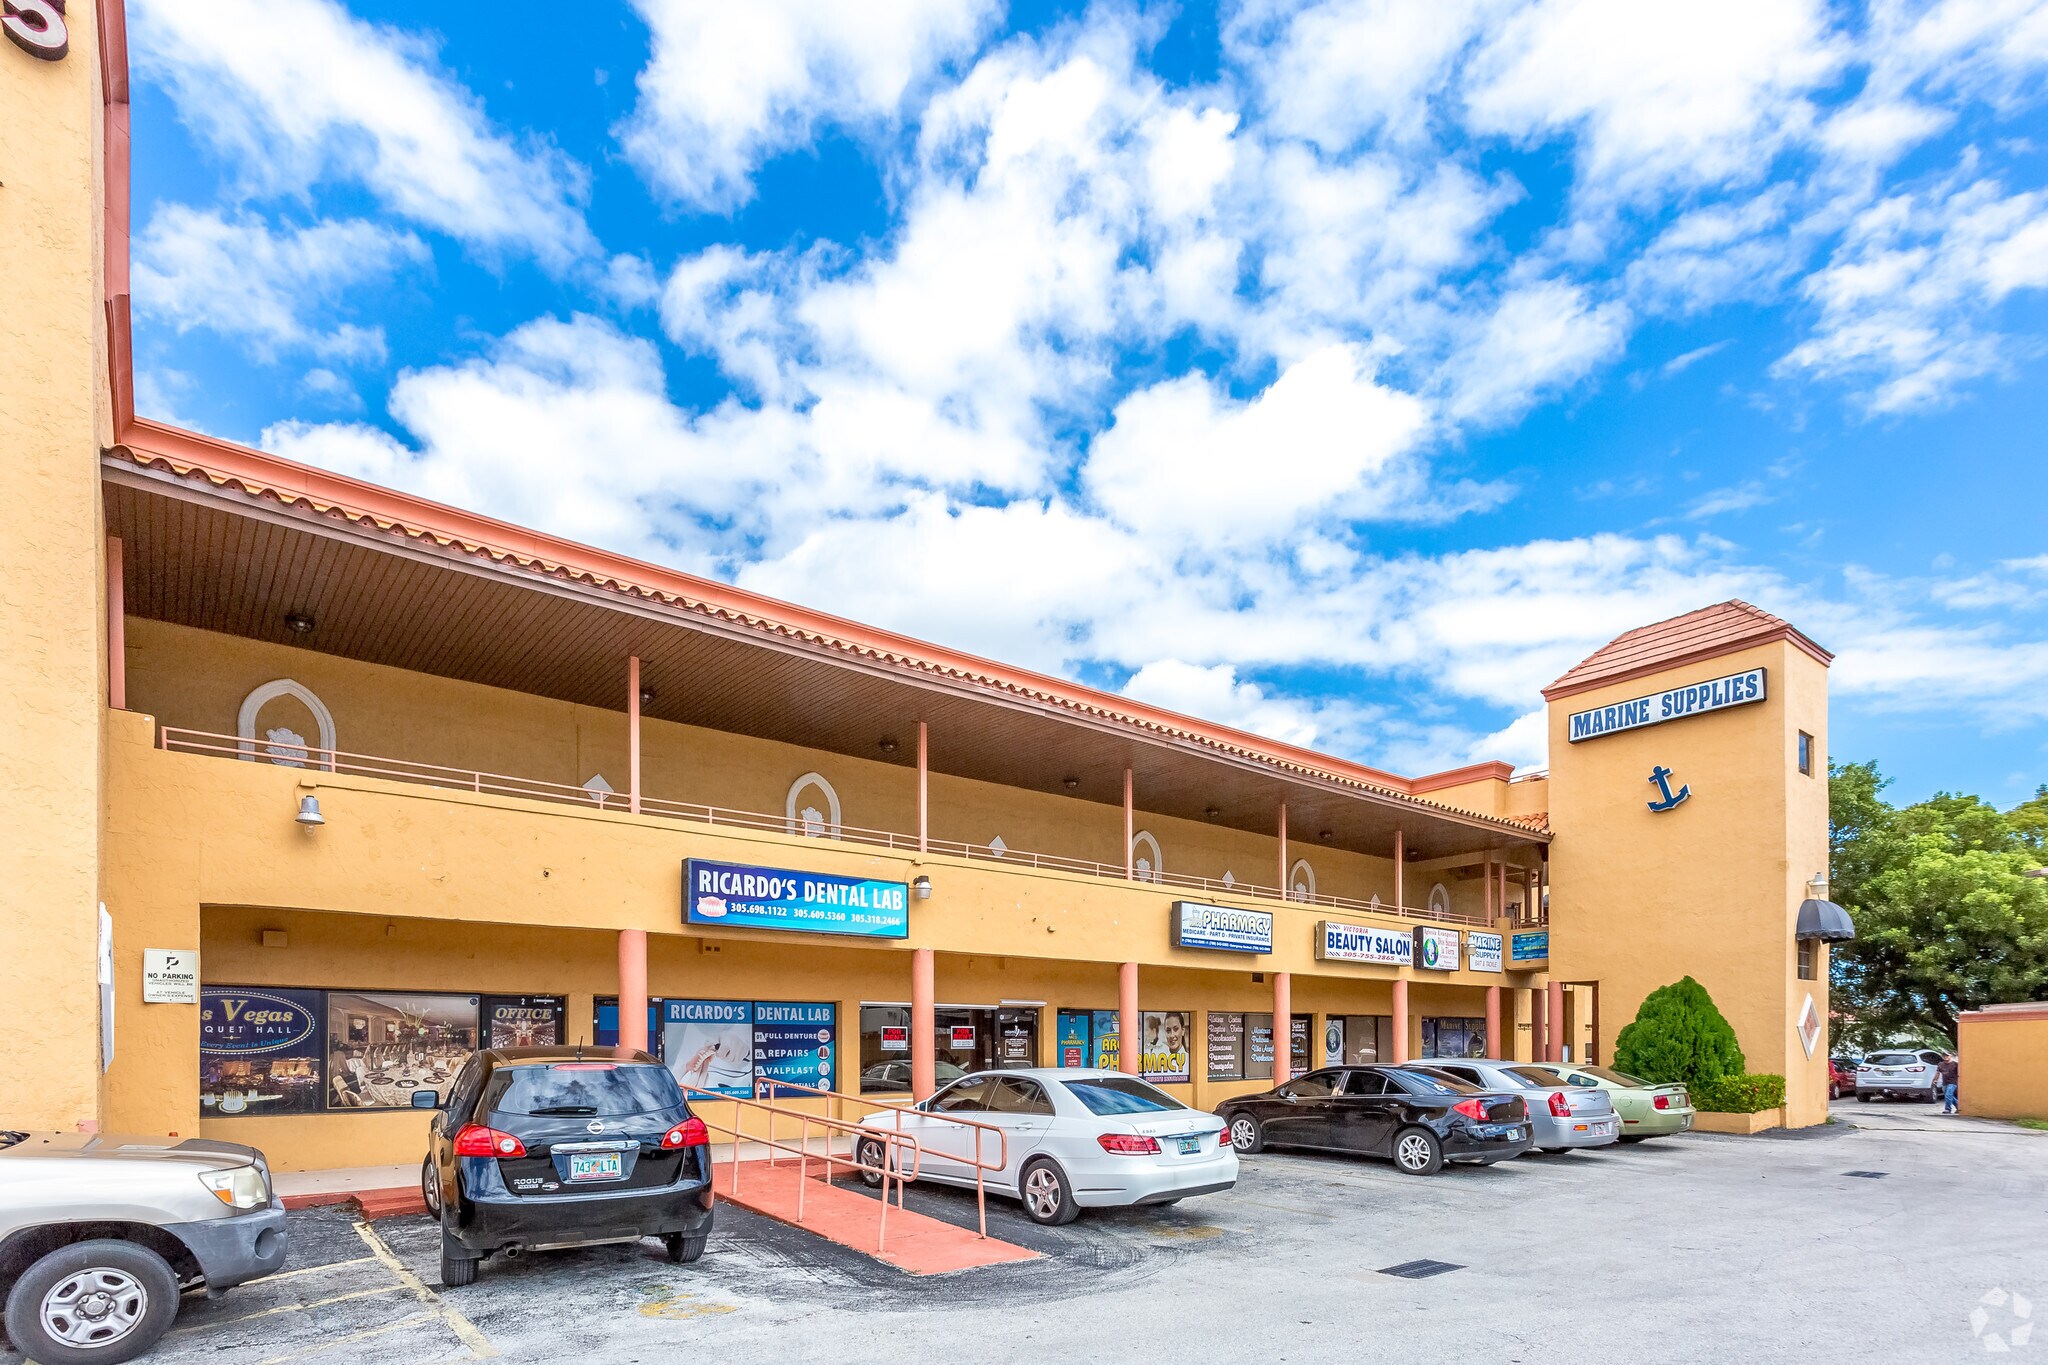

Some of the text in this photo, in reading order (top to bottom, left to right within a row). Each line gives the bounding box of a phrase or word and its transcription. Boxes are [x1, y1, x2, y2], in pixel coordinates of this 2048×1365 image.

[1574, 673, 1758, 738] MARINE SUPPLIES
[698, 869, 903, 911] RICARDO'S DENTAL LAB
[730, 902, 900, 926] 305.698.1122 305.609.5360 305.318.2466
[1203, 910, 1271, 936] PHARMACY
[1183, 928, 1206, 936] MEDICARE
[1343, 925, 1369, 934] VICTORIA
[1328, 932, 1410, 956] BEAUTY SALON
[1471, 935, 1501, 951] MARINE
[1343, 952, 1395, 961] 305-755-2865
[1475, 951, 1496, 960] SUPPLY
[521, 997, 526, 1005] 2
[220, 999, 294, 1025] Vegas
[495, 1007, 552, 1020] OFFICE
[670, 1004, 830, 1021] RICARDO'S DENTAL LAB
[204, 1025, 291, 1034] QUET HALL
[1464, 1020, 1486, 1031] Supplie
[200, 1040, 224, 1049] Every
[260, 1037, 289, 1047] Unique
[768, 1049, 809, 1057] REPAIRS
[1098, 1053, 1185, 1073] PHRMACY
[766, 1066, 814, 1074] VALPLAST
[574, 1160, 618, 1173] 743 LTA
[514, 1177, 544, 1186] ROGUE
